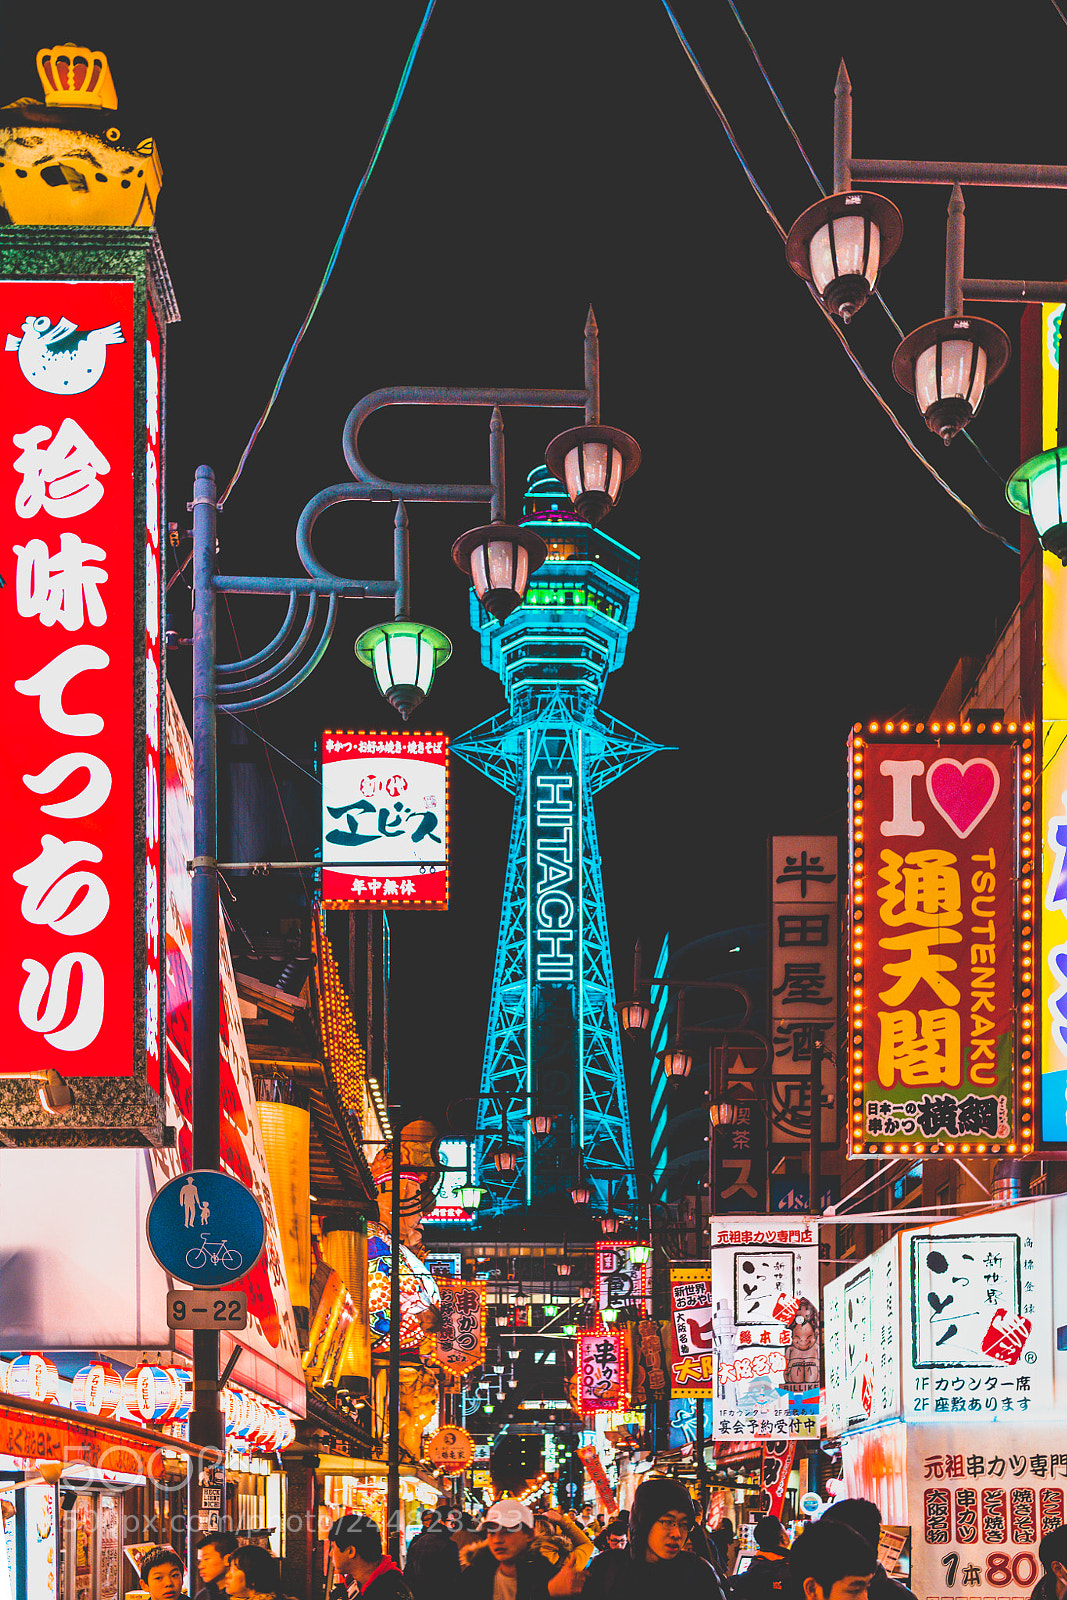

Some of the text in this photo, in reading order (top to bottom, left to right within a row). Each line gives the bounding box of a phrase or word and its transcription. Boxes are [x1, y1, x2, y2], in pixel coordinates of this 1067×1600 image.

[12, 417, 114, 1053] 珍味てっちり
[879, 759, 926, 838] I
[350, 877, 417, 897] 年中無休
[536, 775, 574, 981] HITACHI
[876, 847, 964, 1089] 通天閣
[969, 847, 998, 1086] TSUTENKAKU
[867, 1102, 917, 1116] 日本一の
[867, 1117, 916, 1136] 串かつ
[916, 1094, 998, 1138] 横綱
[777, 1188, 832, 1211] Asai
[716, 1229, 814, 1244] 元祖串カツ専門店
[673, 1283, 707, 1298] 新世界
[454, 1287, 480, 1352] 串かつ
[593, 1339, 619, 1393] 串かつ
[915, 1376, 1031, 1392] 1F カウンター席
[140, 1376, 151, 1410] アサヒビール
[914, 1397, 1031, 1412] 2F 座敷あります
[718, 1419, 816, 1434] 宴会予約受付中
[926, 1489, 949, 1543] 大阪名物
[956, 1489, 977, 1543] 串カツ
[984, 1489, 1006, 1543] どて焼き
[1012, 1489, 1033, 1543] 焼きそば
[1042, 1489, 1064, 1535] たこ焼
